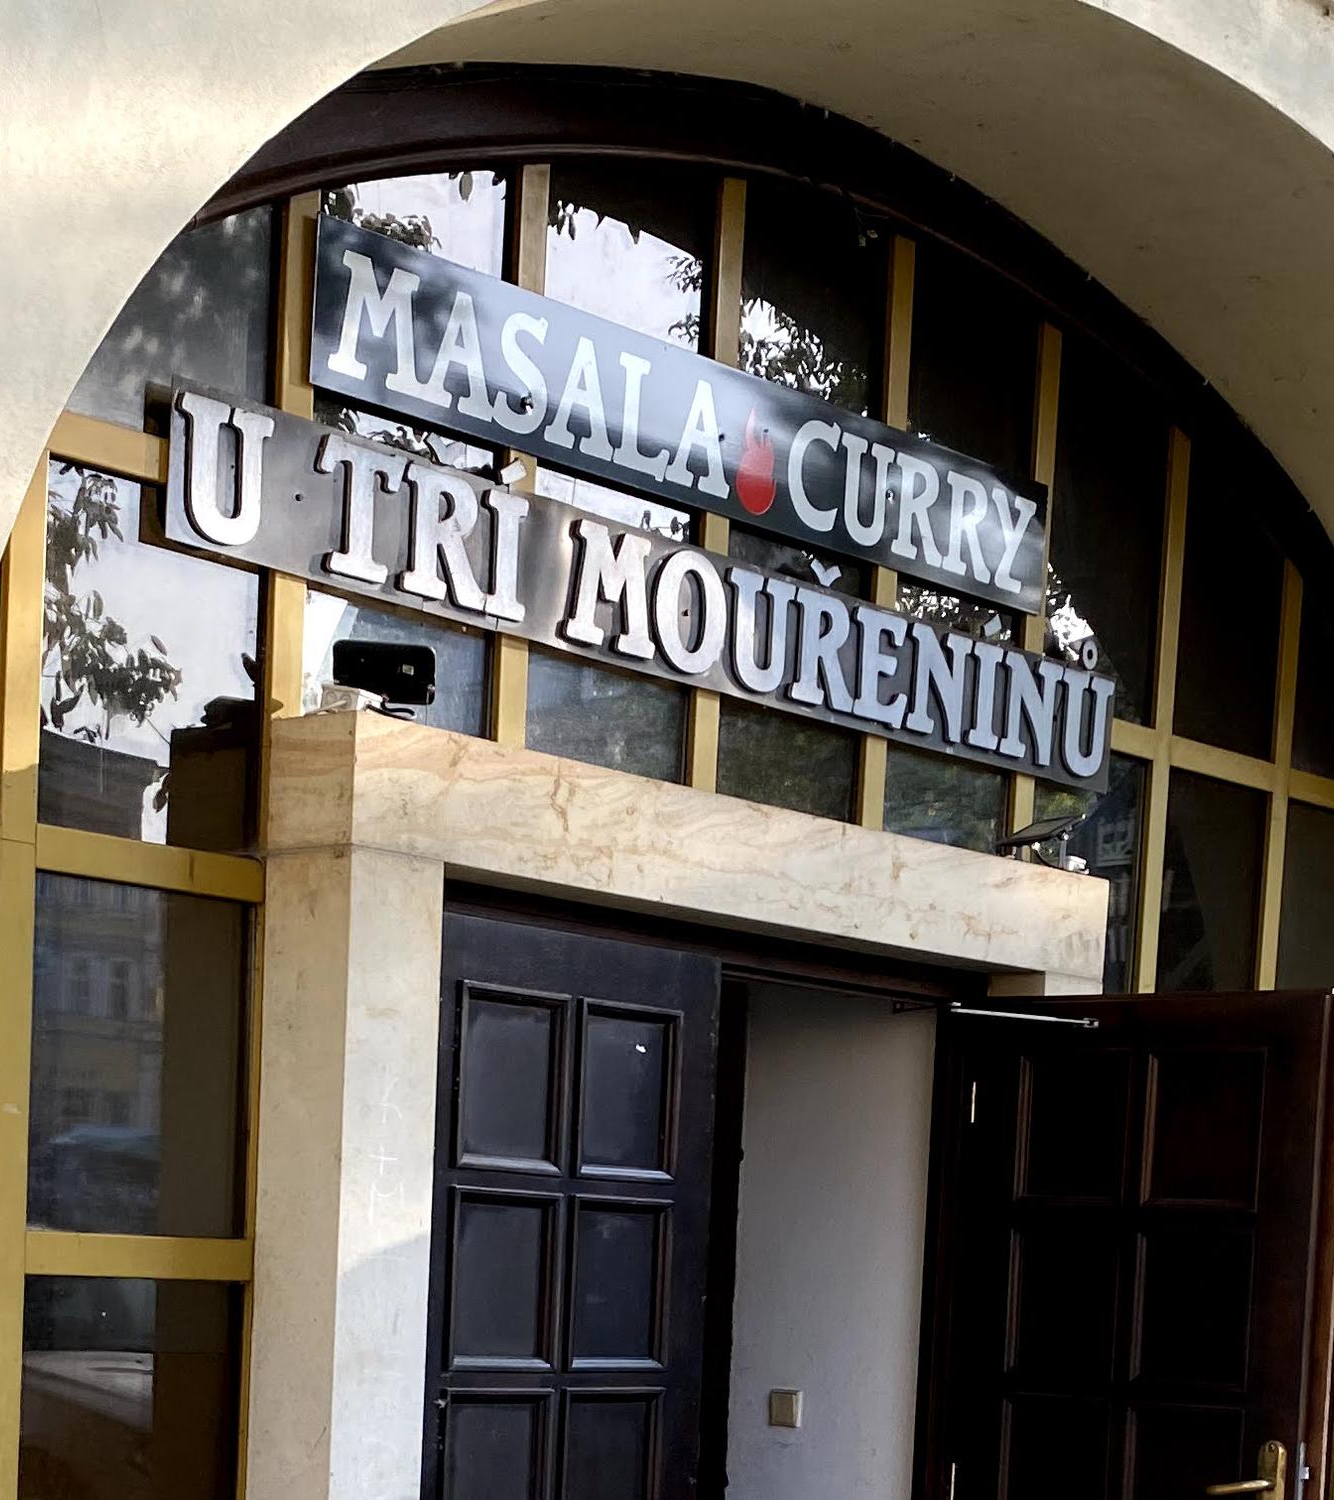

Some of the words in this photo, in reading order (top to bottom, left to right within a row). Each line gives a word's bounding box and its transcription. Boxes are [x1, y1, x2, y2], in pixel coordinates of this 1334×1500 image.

[174, 390, 275, 546] U
[555, 518, 1114, 778] MOUŘENÍNŮ
[327, 250, 730, 499] MASALA
[787, 419, 1037, 595] CURRY
